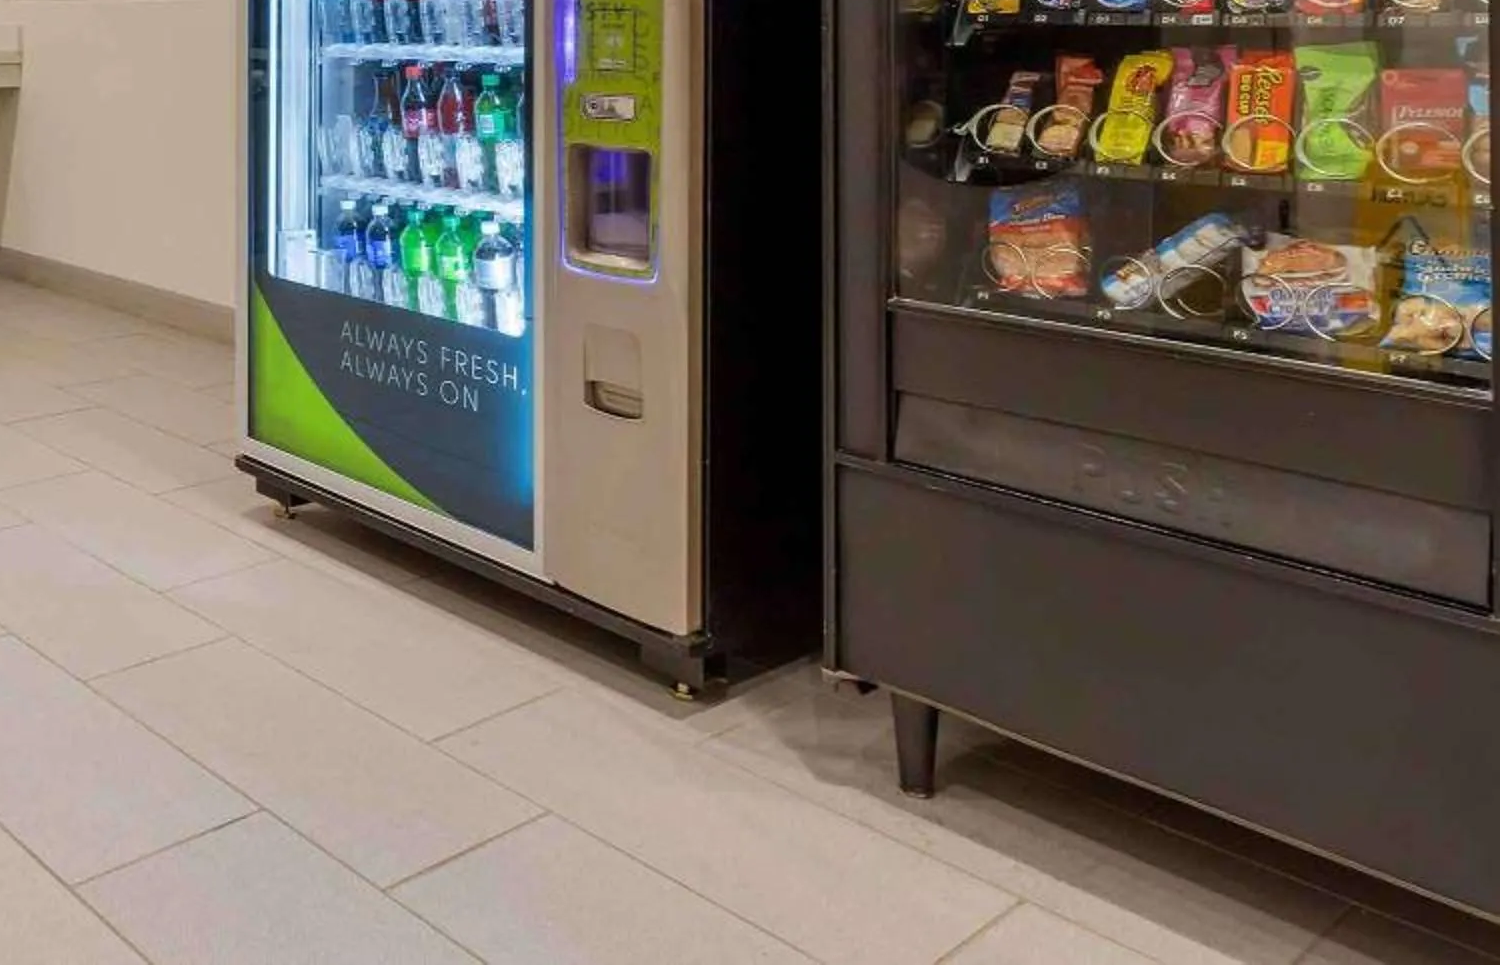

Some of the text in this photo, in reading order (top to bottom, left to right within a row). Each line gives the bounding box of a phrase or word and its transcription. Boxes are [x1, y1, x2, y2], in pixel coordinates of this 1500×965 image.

[1239, 93, 1252, 115] CUP
[339, 320, 528, 396] ALWAYS FRESH.
[339, 351, 480, 413] ALWAYS ON
